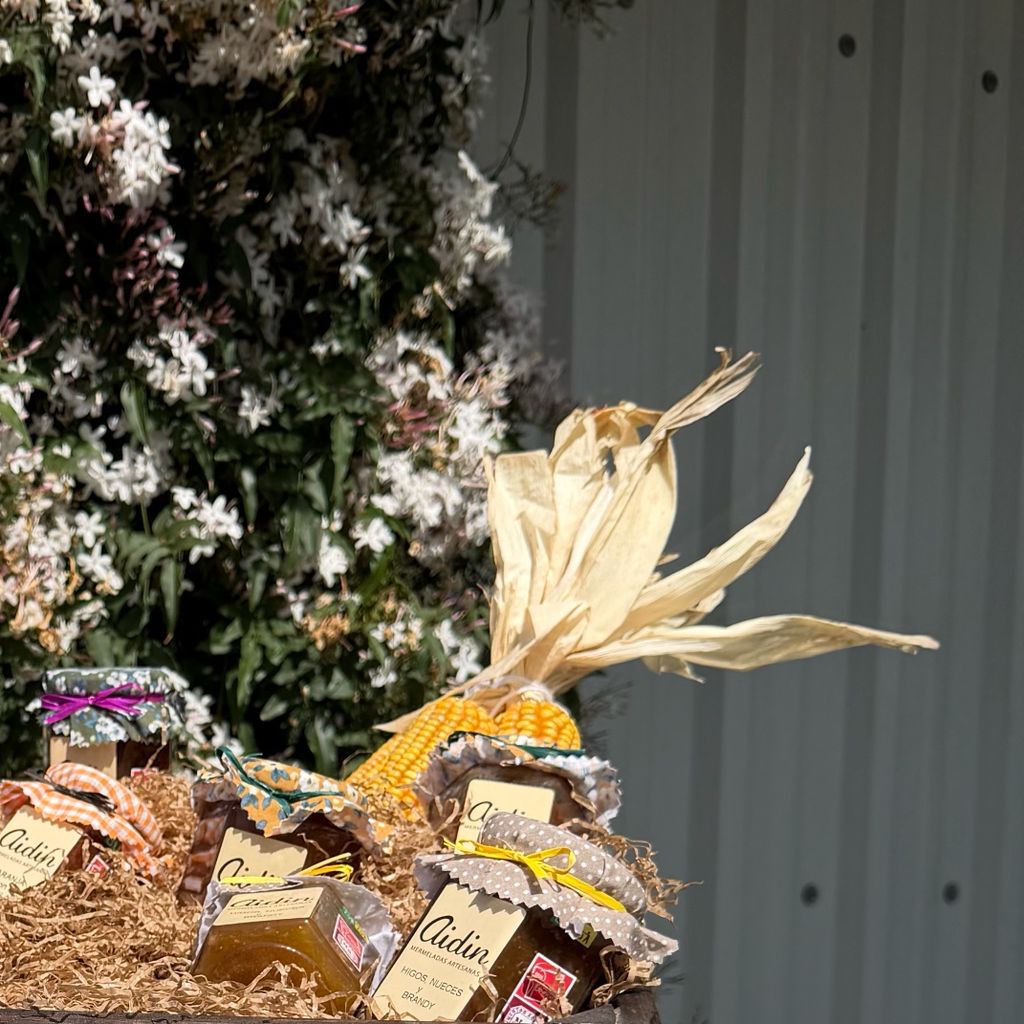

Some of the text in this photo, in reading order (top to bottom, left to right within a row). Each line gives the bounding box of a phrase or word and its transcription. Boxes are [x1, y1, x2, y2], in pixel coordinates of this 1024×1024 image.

[0, 828, 57, 868] Aidin
[419, 915, 489, 965] Aidin
[410, 945, 481, 977] MERMELADAS ARTESANAS
[401, 990, 437, 1011] BRANDY
[429, 977, 464, 997] NUECES
